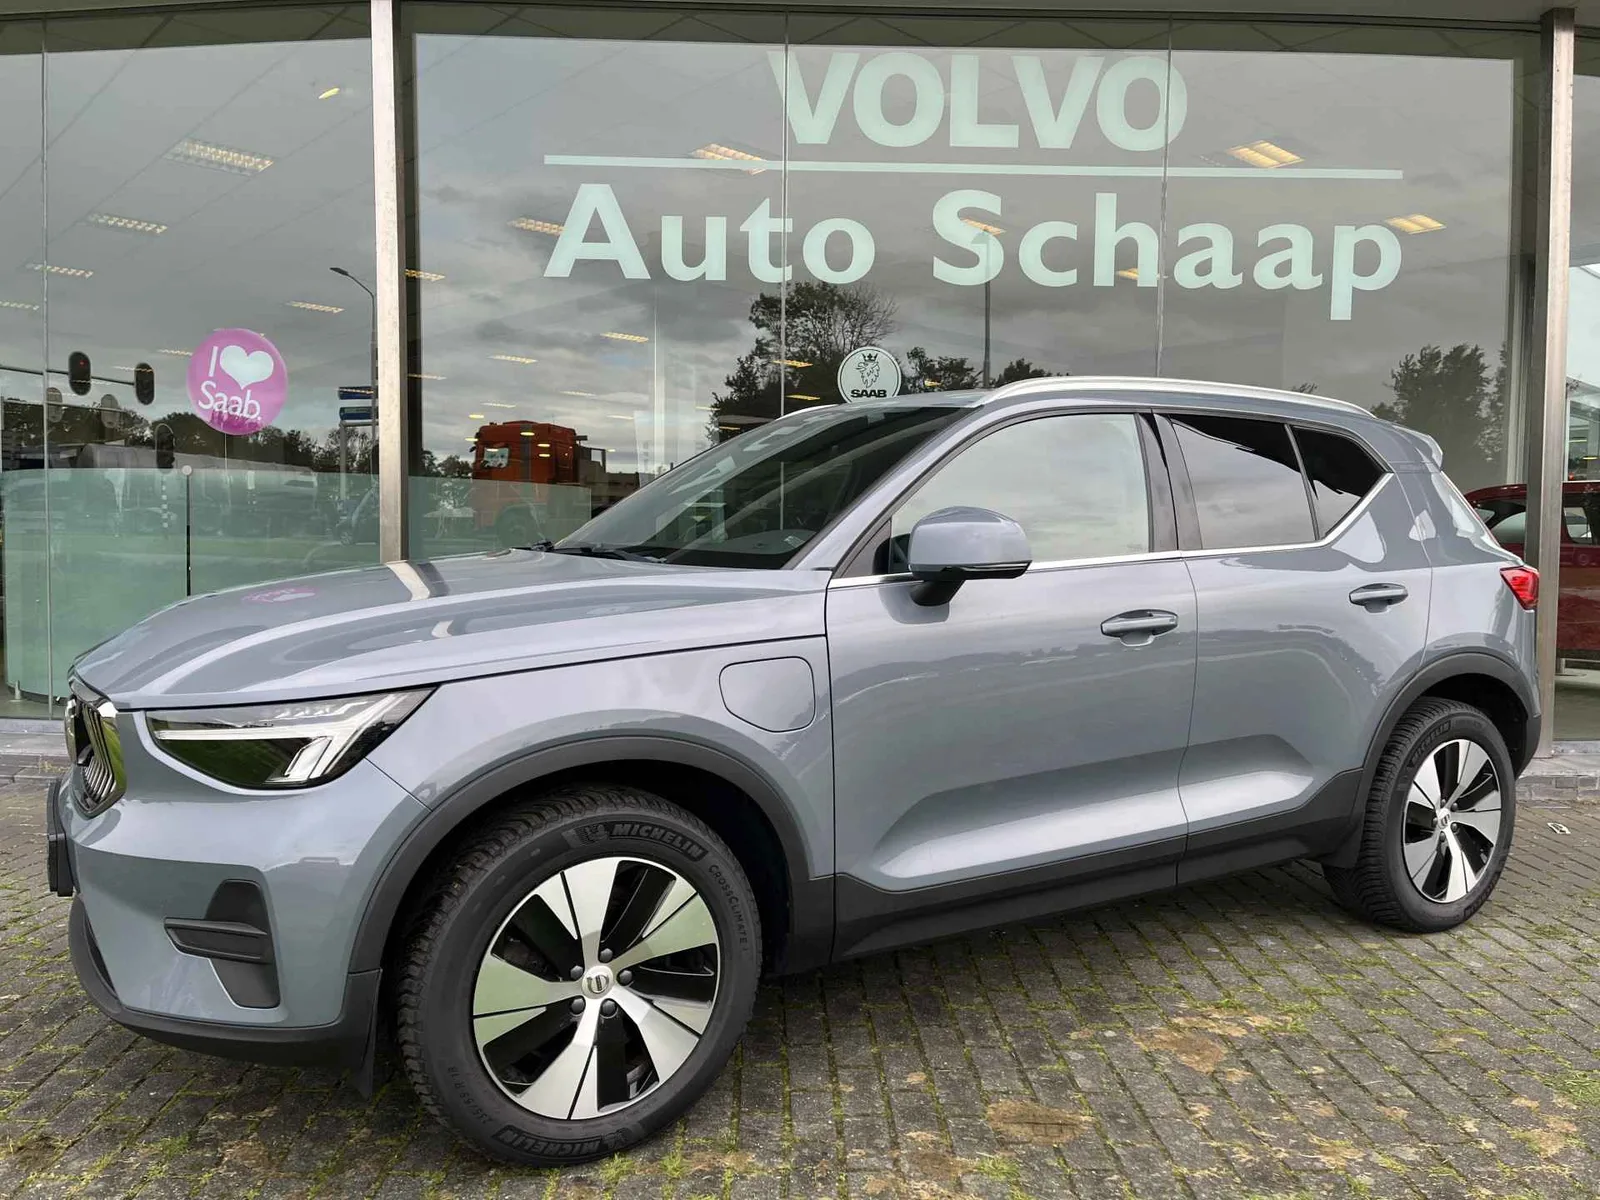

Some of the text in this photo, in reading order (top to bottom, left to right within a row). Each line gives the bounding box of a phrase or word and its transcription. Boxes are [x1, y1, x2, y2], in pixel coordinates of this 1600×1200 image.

[767, 52, 1189, 152] VOLVO
[543, 183, 1403, 322] Auto Schaap
[208, 345, 220, 378] I
[850, 389, 888, 398] SAAB
[611, 823, 704, 859] MICHELIN
[499, 1129, 602, 1157] MICHELIN
